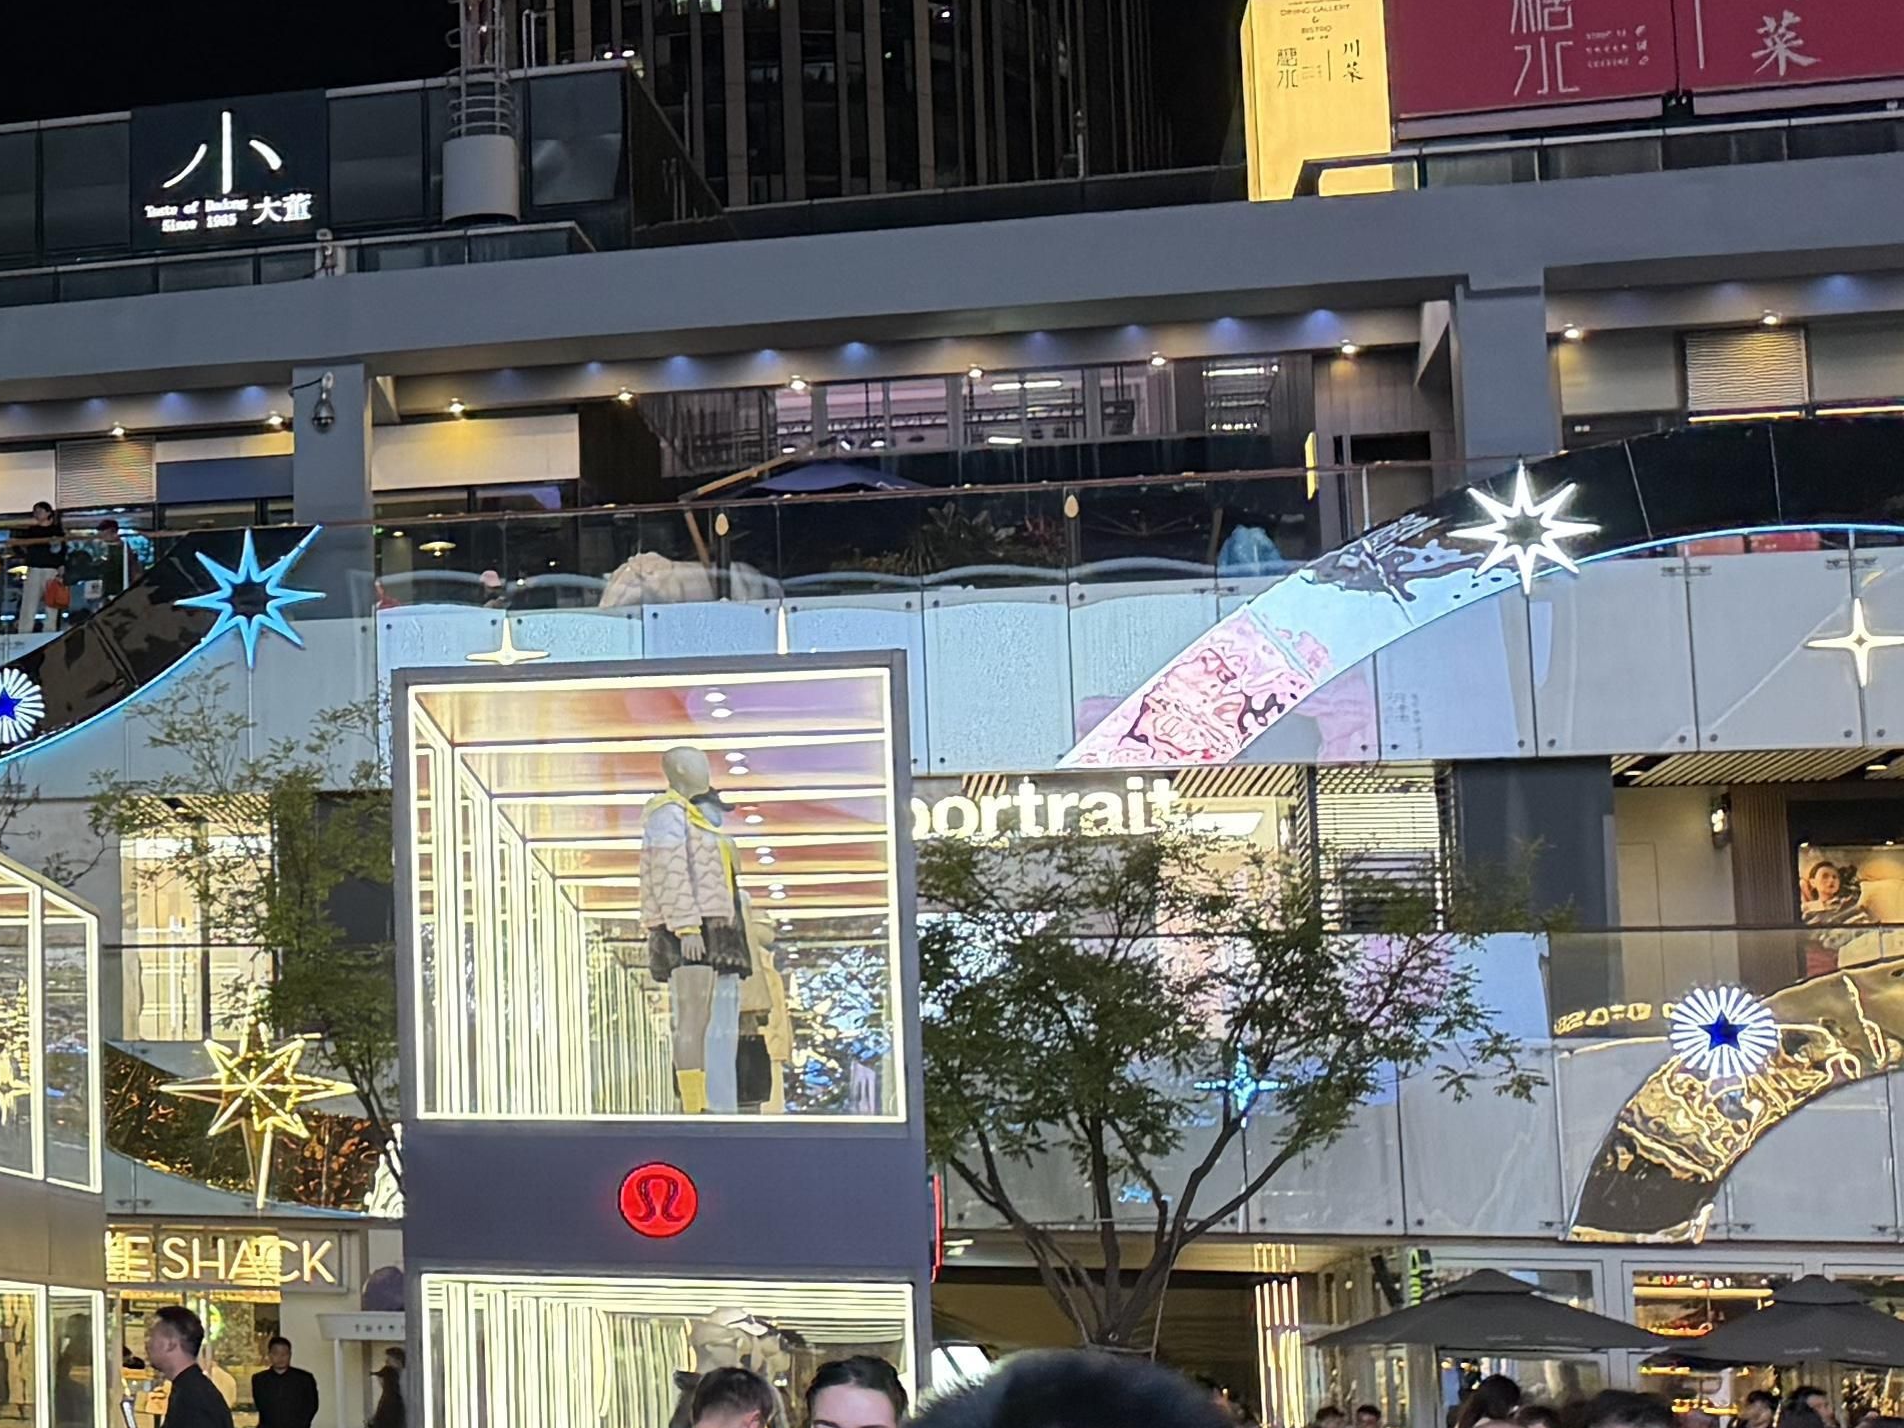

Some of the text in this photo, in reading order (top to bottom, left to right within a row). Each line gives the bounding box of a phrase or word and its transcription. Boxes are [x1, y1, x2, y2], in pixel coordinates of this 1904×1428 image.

[162, 111, 283, 195] 小
[251, 192, 313, 226] 大董
[160, 1235, 337, 1285] SHACK
